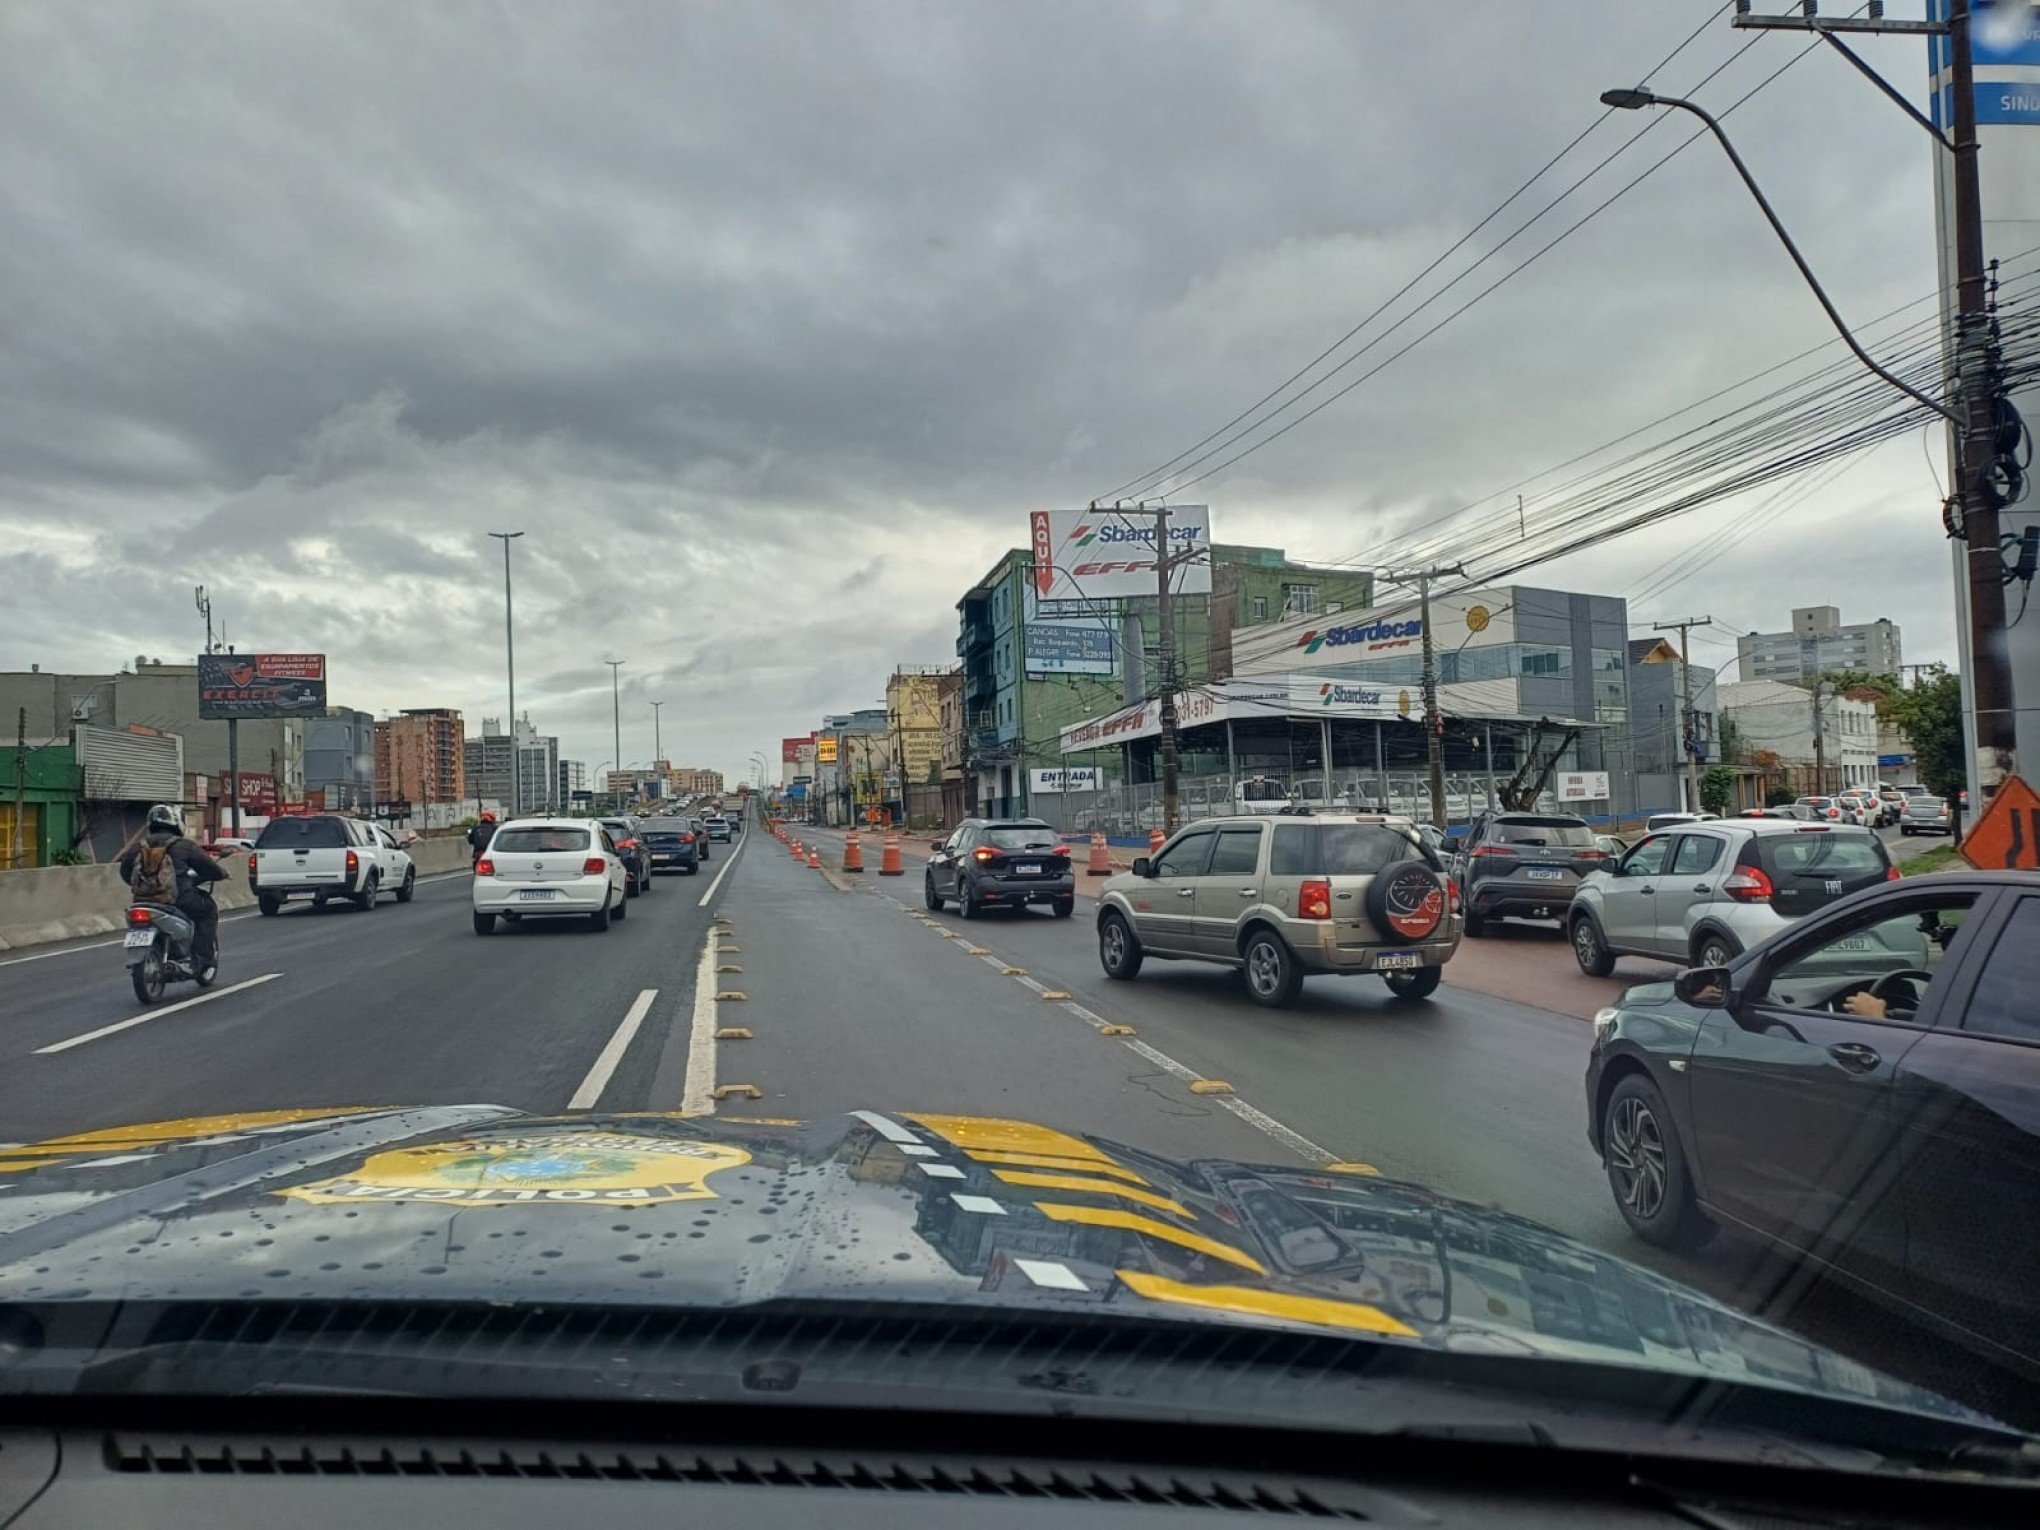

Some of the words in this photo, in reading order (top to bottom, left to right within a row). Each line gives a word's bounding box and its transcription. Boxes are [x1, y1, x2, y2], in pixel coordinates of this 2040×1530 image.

[1100, 525, 1202, 542] Sbardcar
[1036, 515, 1049, 574] AQUI
[1326, 620, 1421, 646] Sbardecar
[1334, 685, 1381, 705] Sbardecar
[1041, 771, 1094, 782] ENTADA
